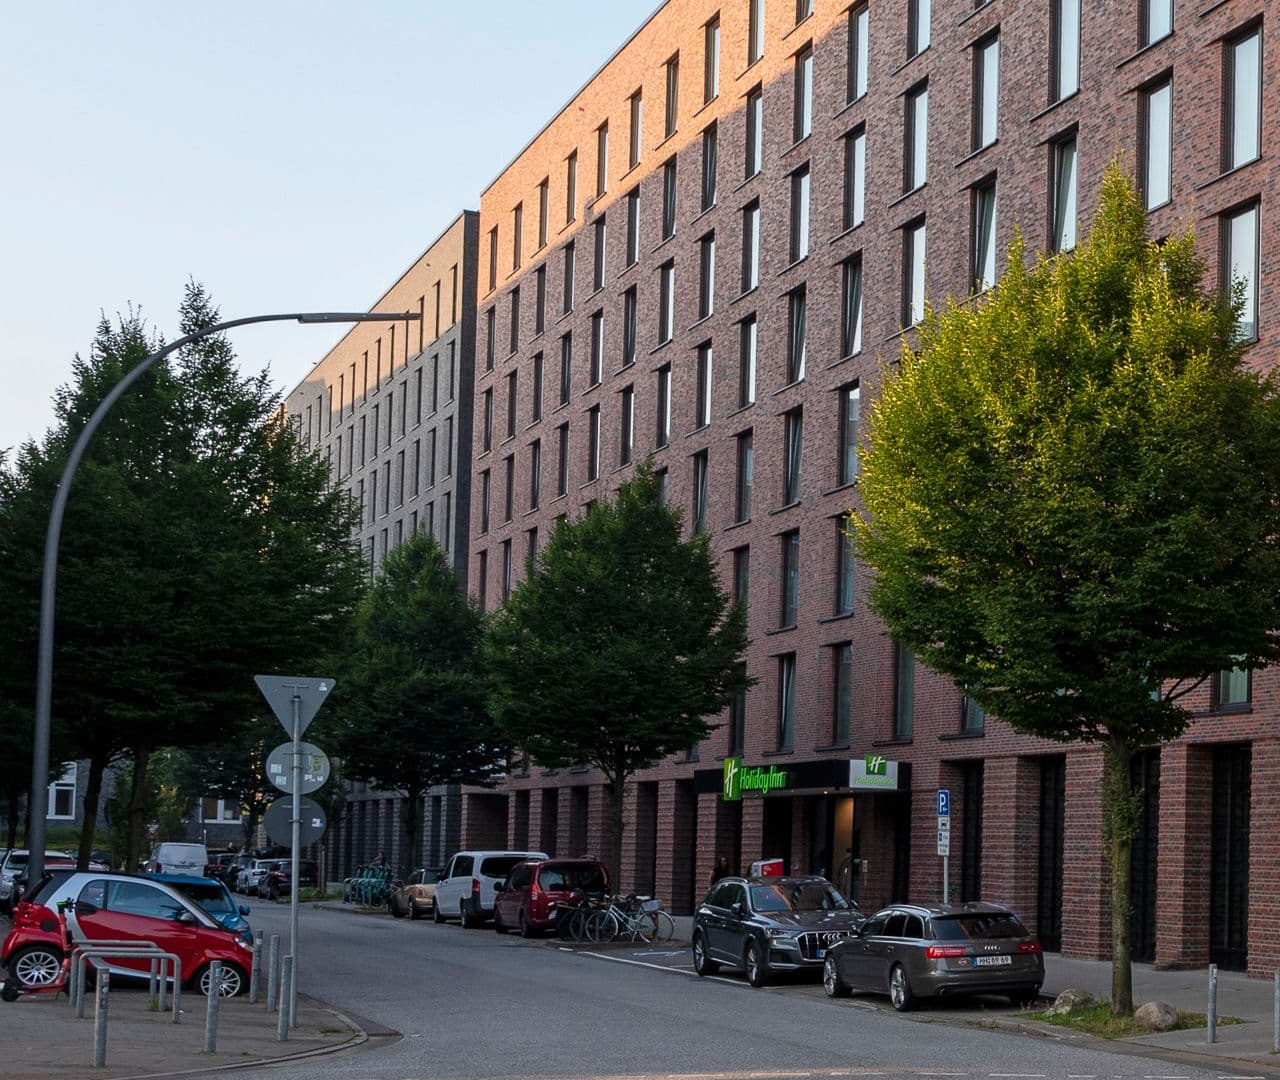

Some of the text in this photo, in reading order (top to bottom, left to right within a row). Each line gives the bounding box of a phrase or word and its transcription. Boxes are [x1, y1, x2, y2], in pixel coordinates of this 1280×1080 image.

[739, 765, 786, 794] Holiday Inn
[939, 793, 947, 814] P
